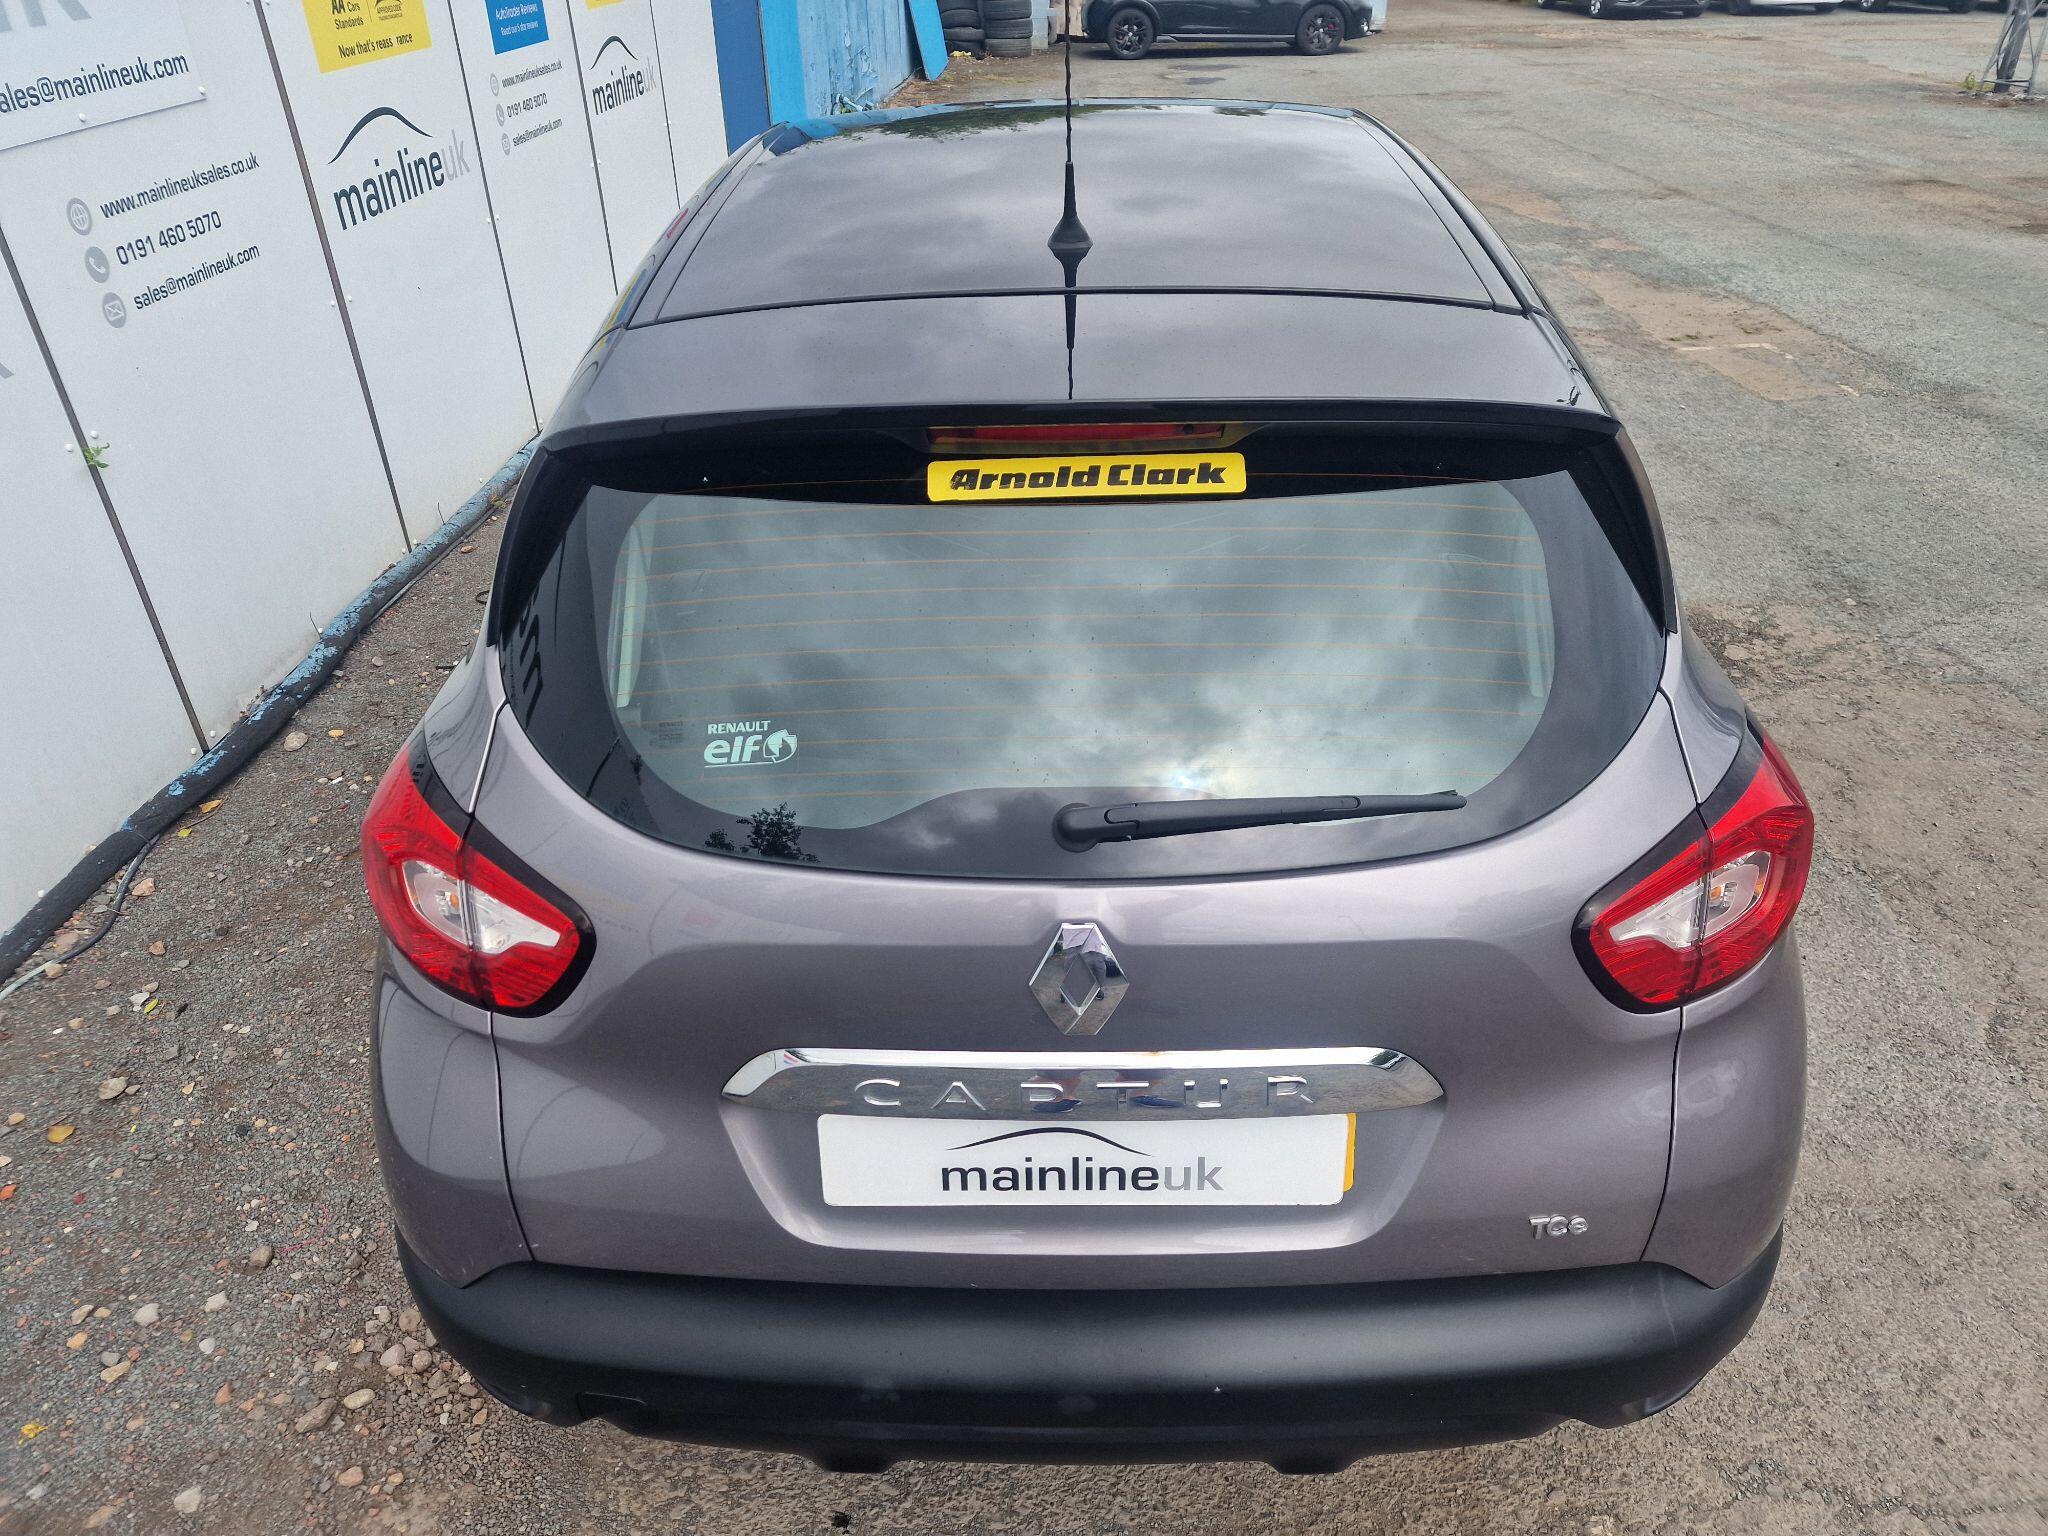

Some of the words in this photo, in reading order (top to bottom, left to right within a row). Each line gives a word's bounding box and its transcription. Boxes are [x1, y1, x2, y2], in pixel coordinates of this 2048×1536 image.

[331, 0, 346, 15] AA
[347, 1, 361, 13] Cars
[334, 16, 364, 30] Standards
[338, 44, 356, 58] Now
[355, 39, 376, 55] that's
[501, 58, 563, 89] www.mainlineuksales.co.uk
[592, 56, 657, 115] mainlineuk
[506, 99, 523, 118] 0191
[522, 96, 534, 112] 460
[533, 92, 548, 108] 5070
[512, 117, 563, 147] sales@mainlineuk.com
[99, 152, 260, 219] www.mainlineuksales.co.uk
[333, 129, 471, 231] mainlineuk
[115, 236, 157, 265] 0191
[158, 223, 187, 250] 460
[188, 210, 222, 238] 5070
[133, 243, 260, 310] sales@mainlineuk.com
[950, 466, 1100, 490] Arnold
[1107, 462, 1228, 487] Clark
[707, 720, 771, 734] RENAULT
[703, 735, 763, 764] elf
[854, 1076, 1315, 1112] CAPTUR
[940, 1157, 1224, 1193] mainlineuk
